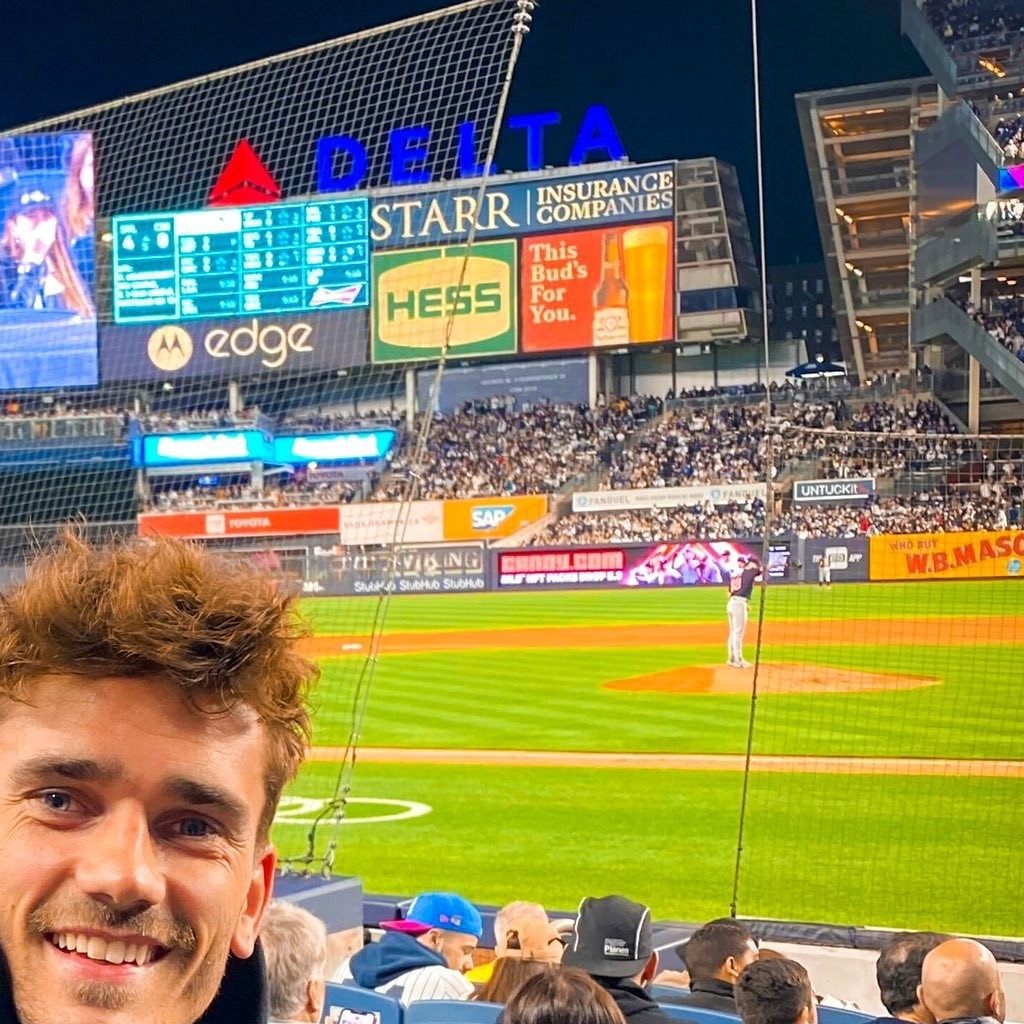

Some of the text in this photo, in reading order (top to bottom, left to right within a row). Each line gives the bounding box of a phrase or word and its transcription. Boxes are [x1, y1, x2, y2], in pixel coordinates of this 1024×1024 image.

[317, 104, 627, 193] DELTA
[536, 170, 674, 205] INSURANCE
[370, 191, 520, 241] STARR
[536, 190, 674, 225] COMPANIES
[529, 243, 578, 264] This
[530, 261, 588, 283] Bud's
[387, 281, 502, 322] HESS
[531, 285, 566, 303] For
[530, 303, 576, 324] You.
[204, 317, 314, 368] edge
[801, 483, 858, 496] UNTUCKit
[229, 517, 271, 528] TOYOTA
[472, 506, 506, 529] SAP
[889, 540, 938, 550] WHO BUY
[399, 580, 440, 592] StubHub
[443, 578, 485, 590] StubHub
